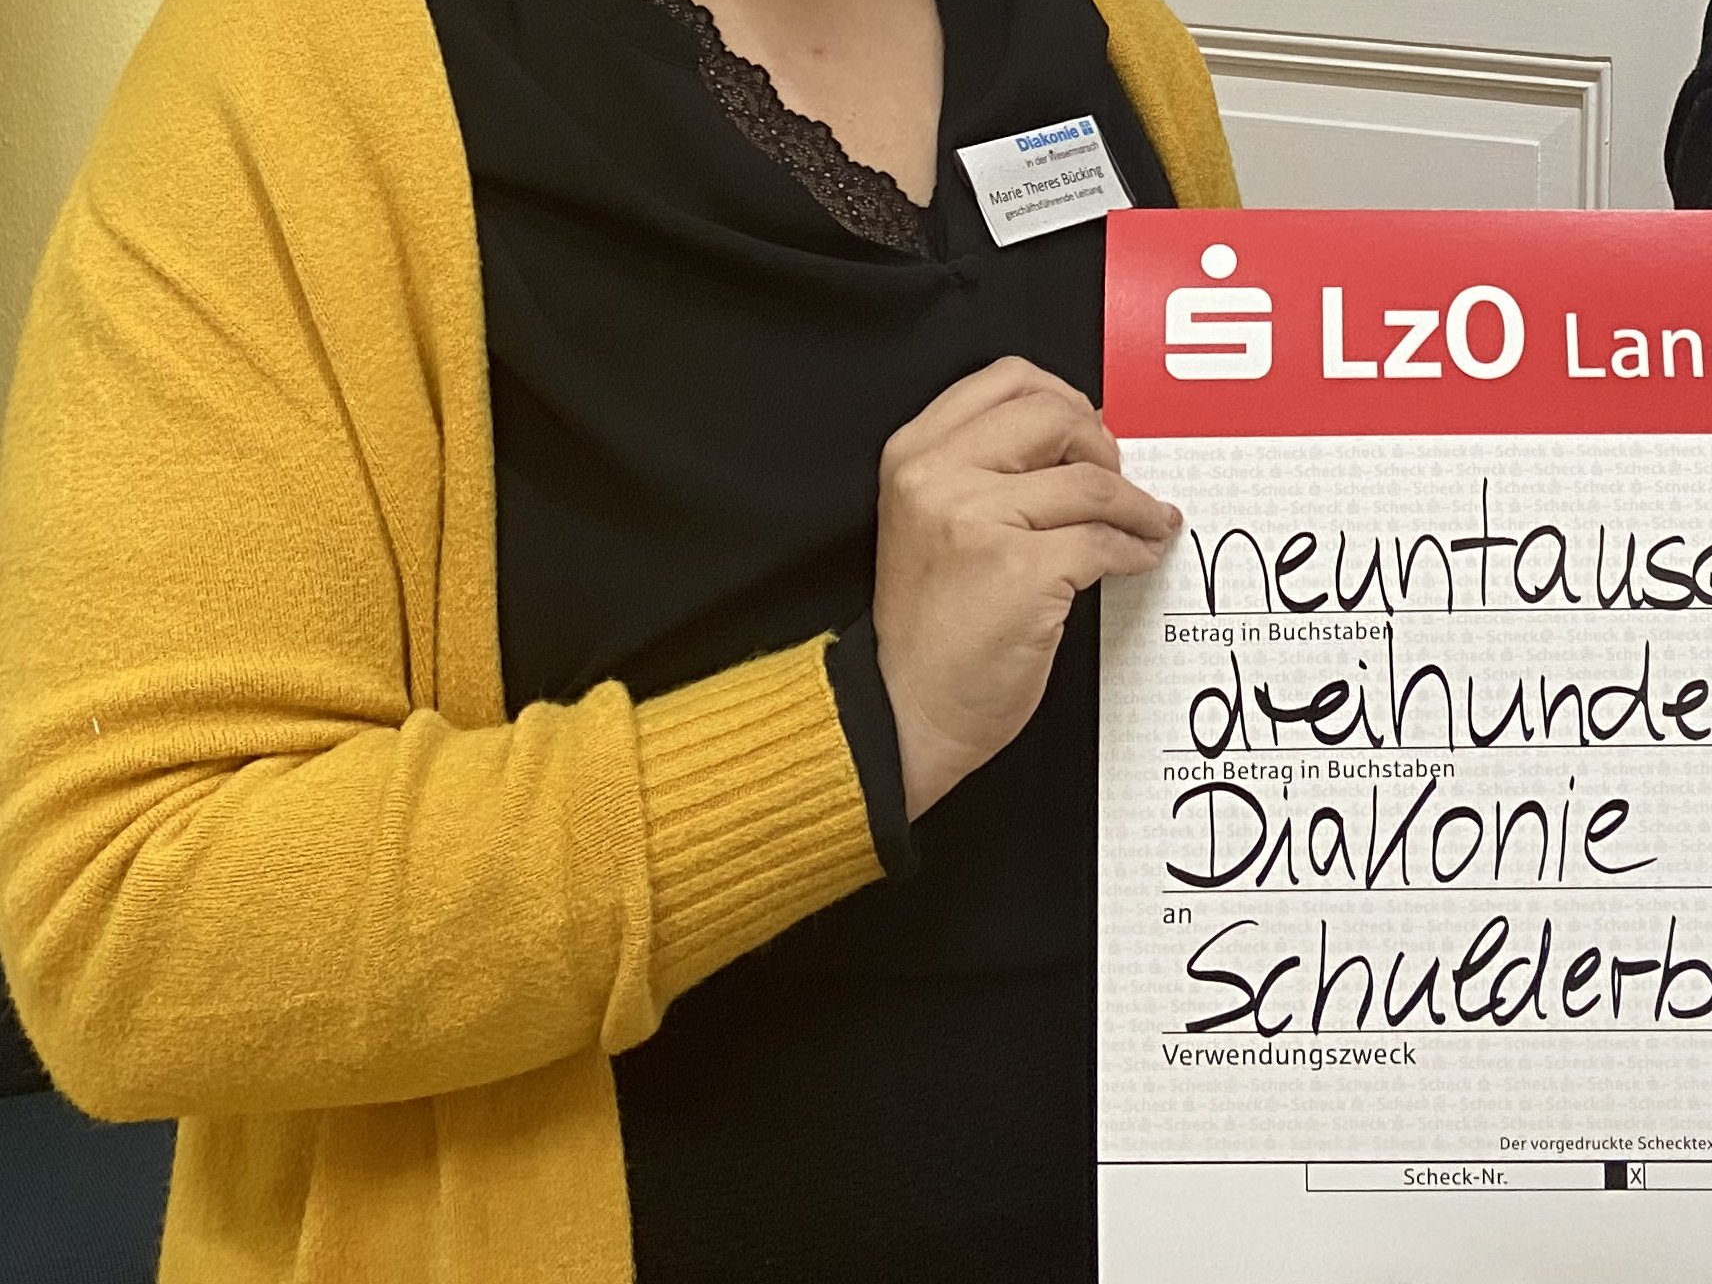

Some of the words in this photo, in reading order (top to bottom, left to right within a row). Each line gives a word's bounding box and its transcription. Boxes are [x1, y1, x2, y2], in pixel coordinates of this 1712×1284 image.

[1015, 125, 1080, 152] Diakonie
[989, 187, 1024, 205] Marie
[1023, 177, 1061, 196] Theres
[1061, 165, 1105, 185] Bücking
[1005, 193, 1075, 221] geschäftsführende
[1321, 284, 1526, 380] LzO
[1164, 624, 1235, 647] Betrag
[1242, 622, 1261, 642] in
[1269, 621, 1394, 642] Buchstaben
[1163, 761, 1214, 780] noch
[1223, 761, 1294, 784] Betrag
[1300, 760, 1320, 779] in
[1328, 758, 1456, 779] Buchstaben
[1163, 907, 1192, 924] an
[1162, 1040, 1416, 1071] Verwendungszweck
[1500, 1136, 1527, 1151] Der
[1531, 1136, 1633, 1154] vorgedruckte
[1403, 1167, 1509, 1186] Scheck-Nr.
[1629, 1167, 1643, 1186] X
